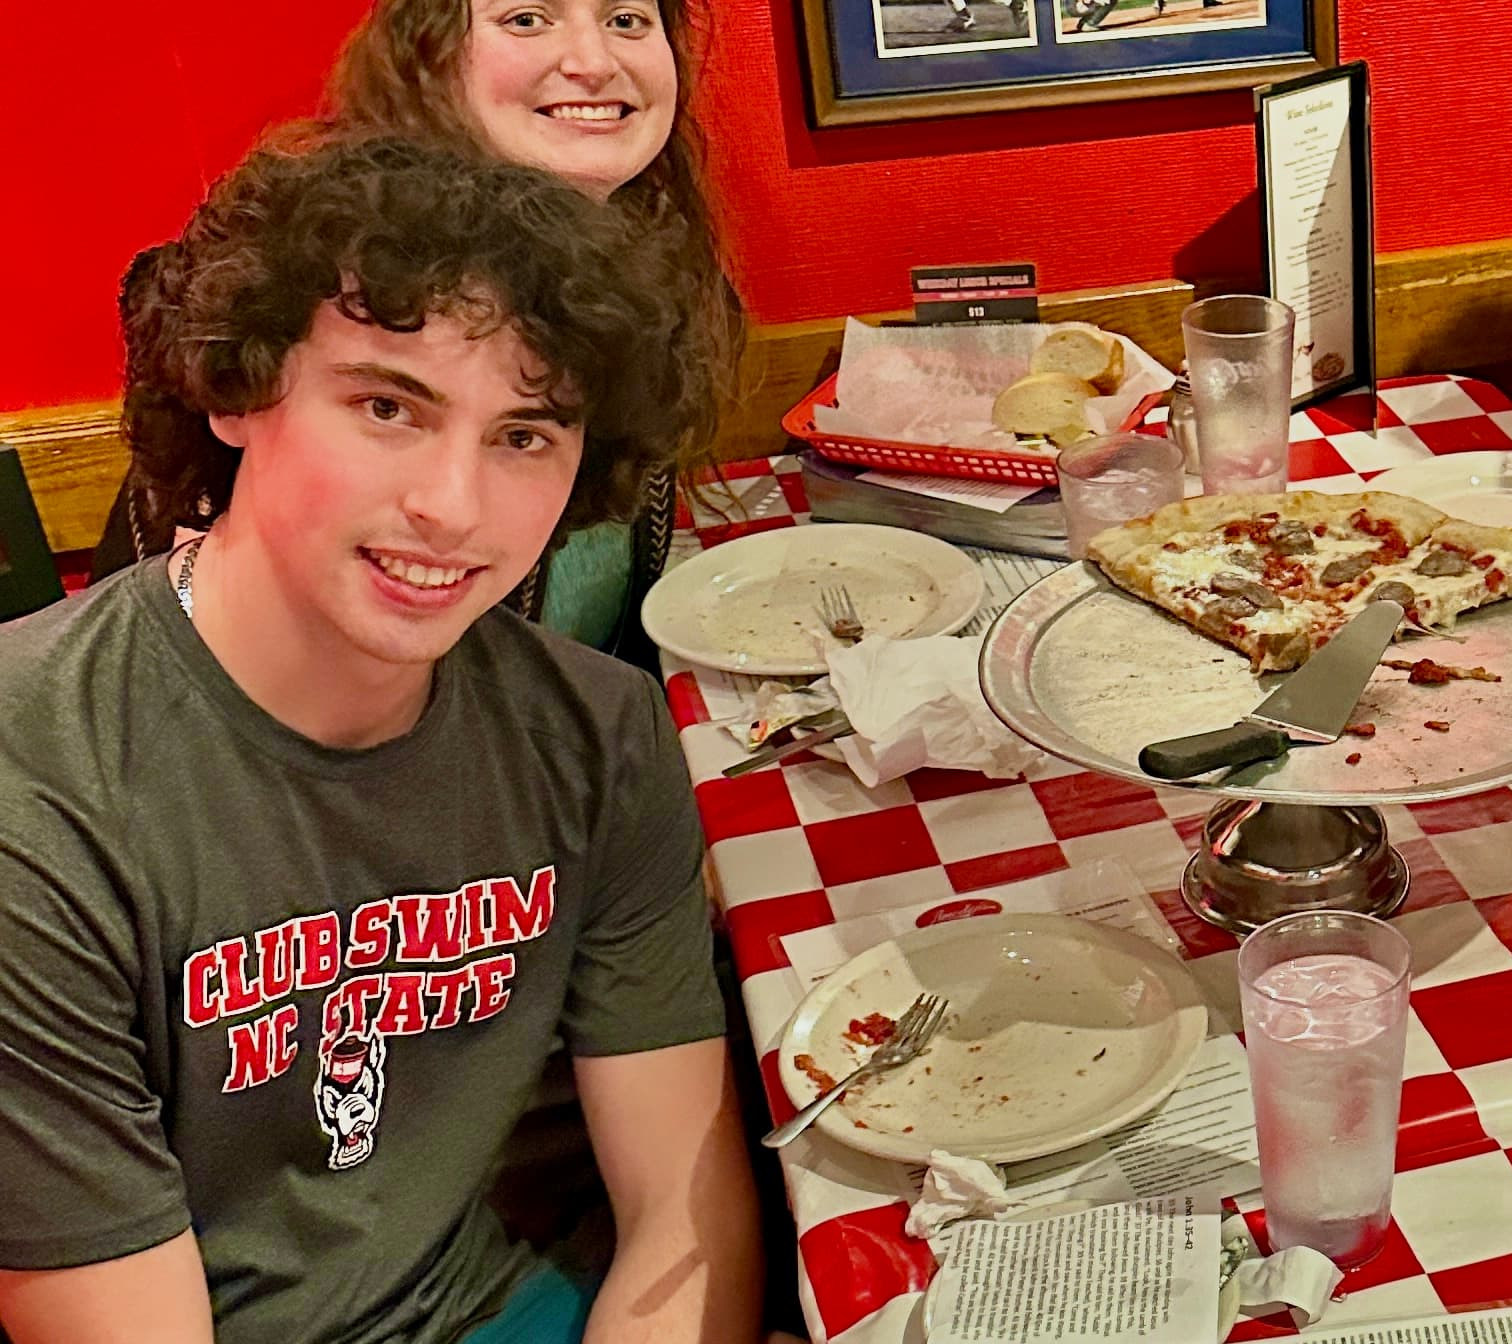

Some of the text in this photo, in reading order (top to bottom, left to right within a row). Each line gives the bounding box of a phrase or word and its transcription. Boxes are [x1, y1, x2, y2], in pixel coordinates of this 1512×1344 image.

[183, 864, 556, 1029] CLUB SWIM
[221, 953, 516, 1093] NC STATE
[1185, 1196, 1195, 1216] John
